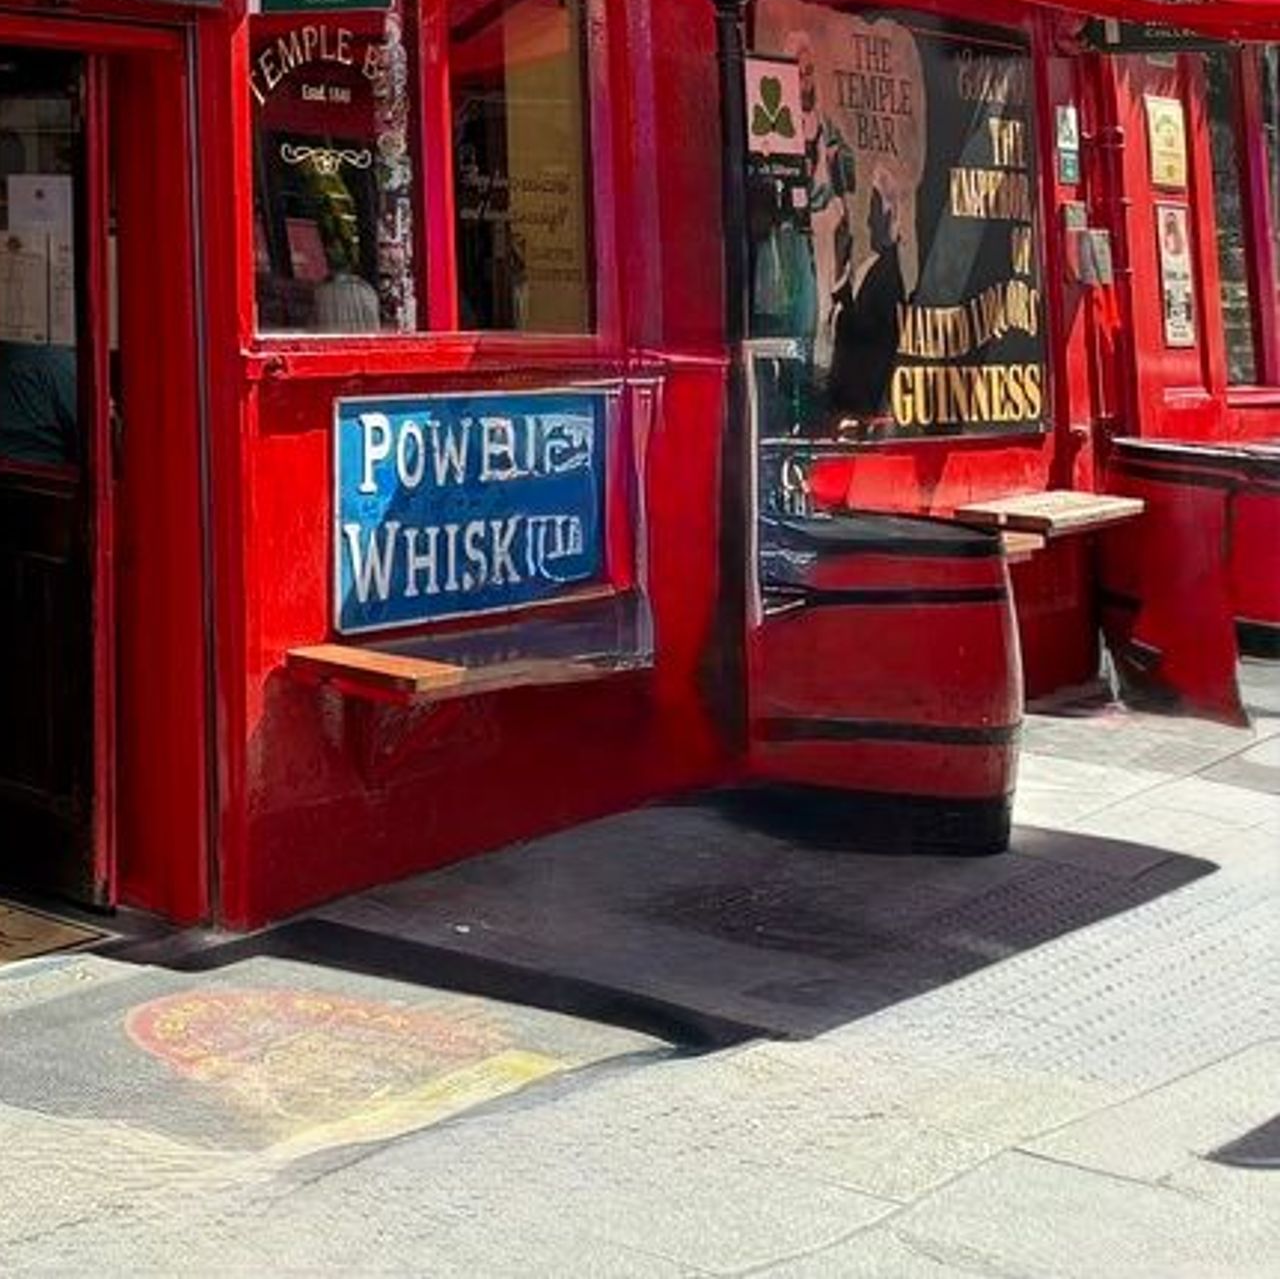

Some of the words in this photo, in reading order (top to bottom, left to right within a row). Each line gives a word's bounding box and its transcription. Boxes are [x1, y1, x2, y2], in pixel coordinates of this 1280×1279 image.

[250, 24, 354, 106] TEMPLE
[853, 33, 892, 73] THE
[835, 70, 913, 116] TEMPLE
[857, 116, 898, 158] BAR
[892, 364, 1042, 427] GUINNESS
[343, 515, 583, 602] WHISK
